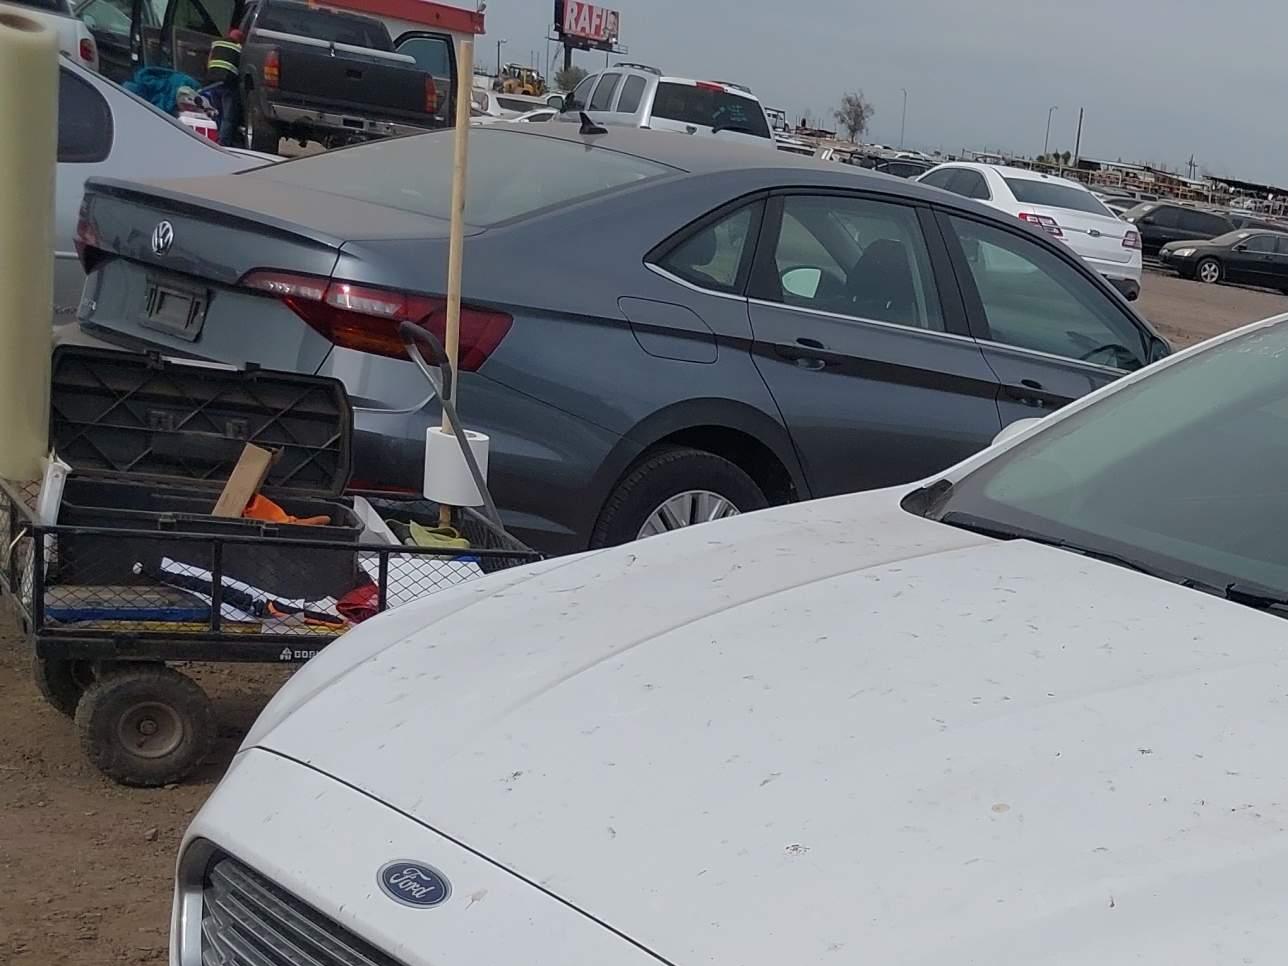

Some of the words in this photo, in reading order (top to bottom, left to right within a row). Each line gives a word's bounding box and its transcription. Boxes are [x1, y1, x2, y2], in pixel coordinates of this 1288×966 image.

[564, 0, 608, 39] RAFI
[294, 650, 319, 659] GOR
[389, 867, 436, 899] Ford
